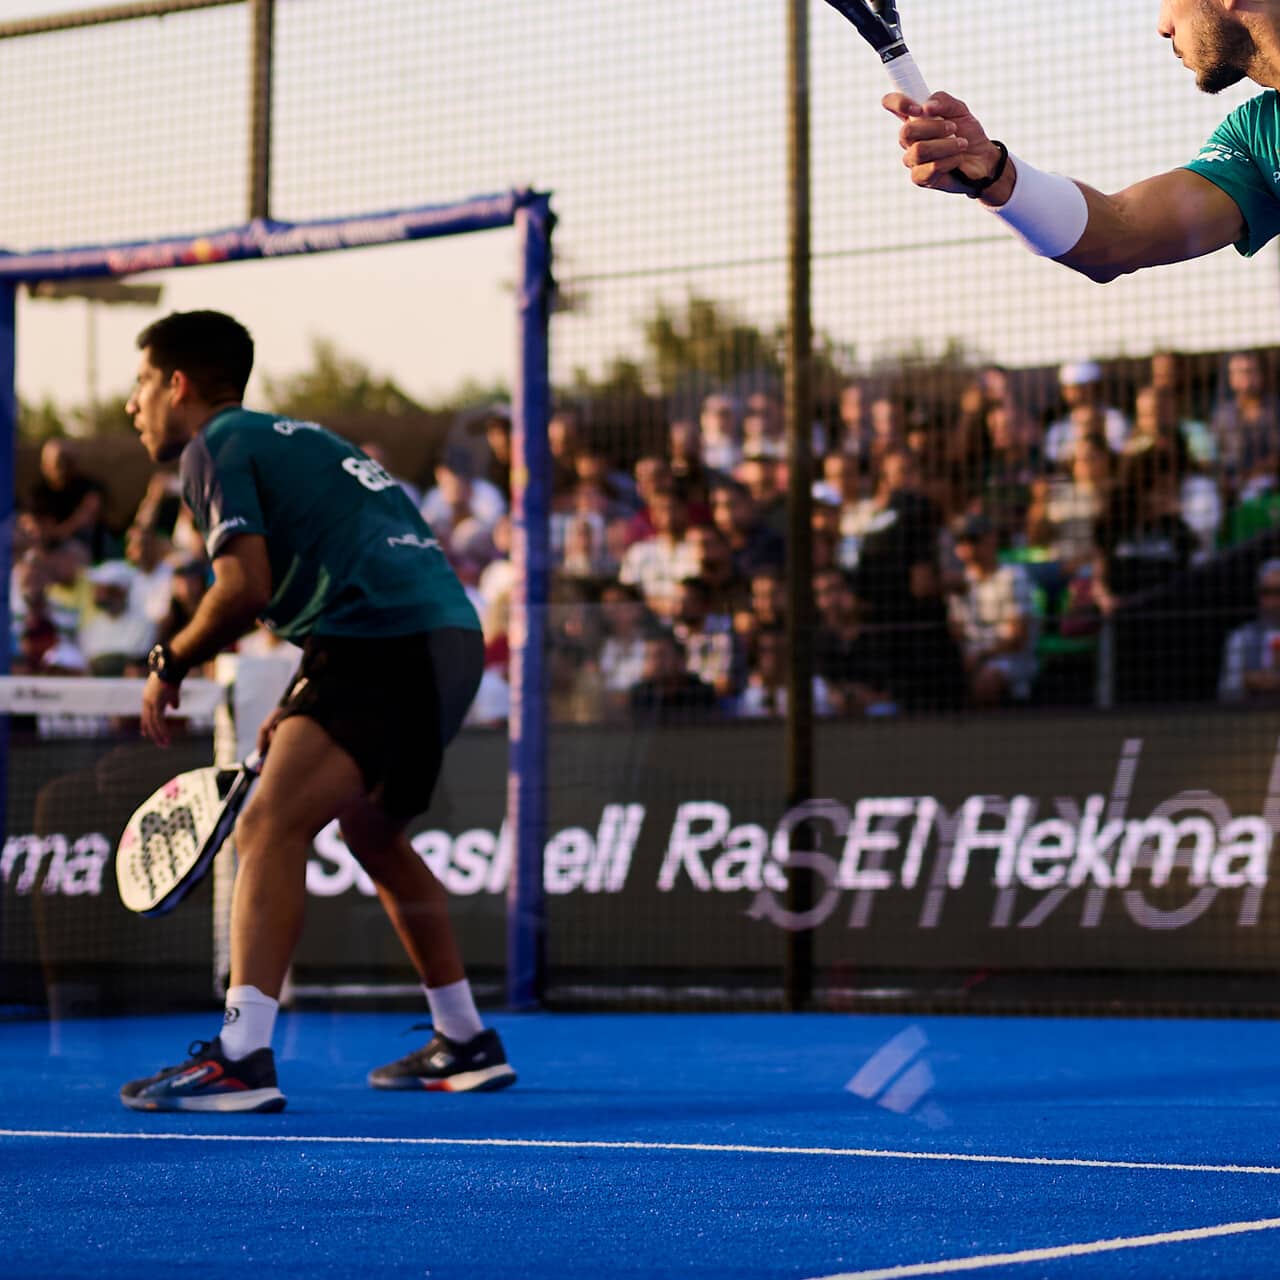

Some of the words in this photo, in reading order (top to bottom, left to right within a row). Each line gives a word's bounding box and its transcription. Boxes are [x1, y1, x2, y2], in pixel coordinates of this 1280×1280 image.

[305, 802, 646, 897] Sasell
[836, 796, 937, 890] El
[947, 794, 1276, 891] Hekma
